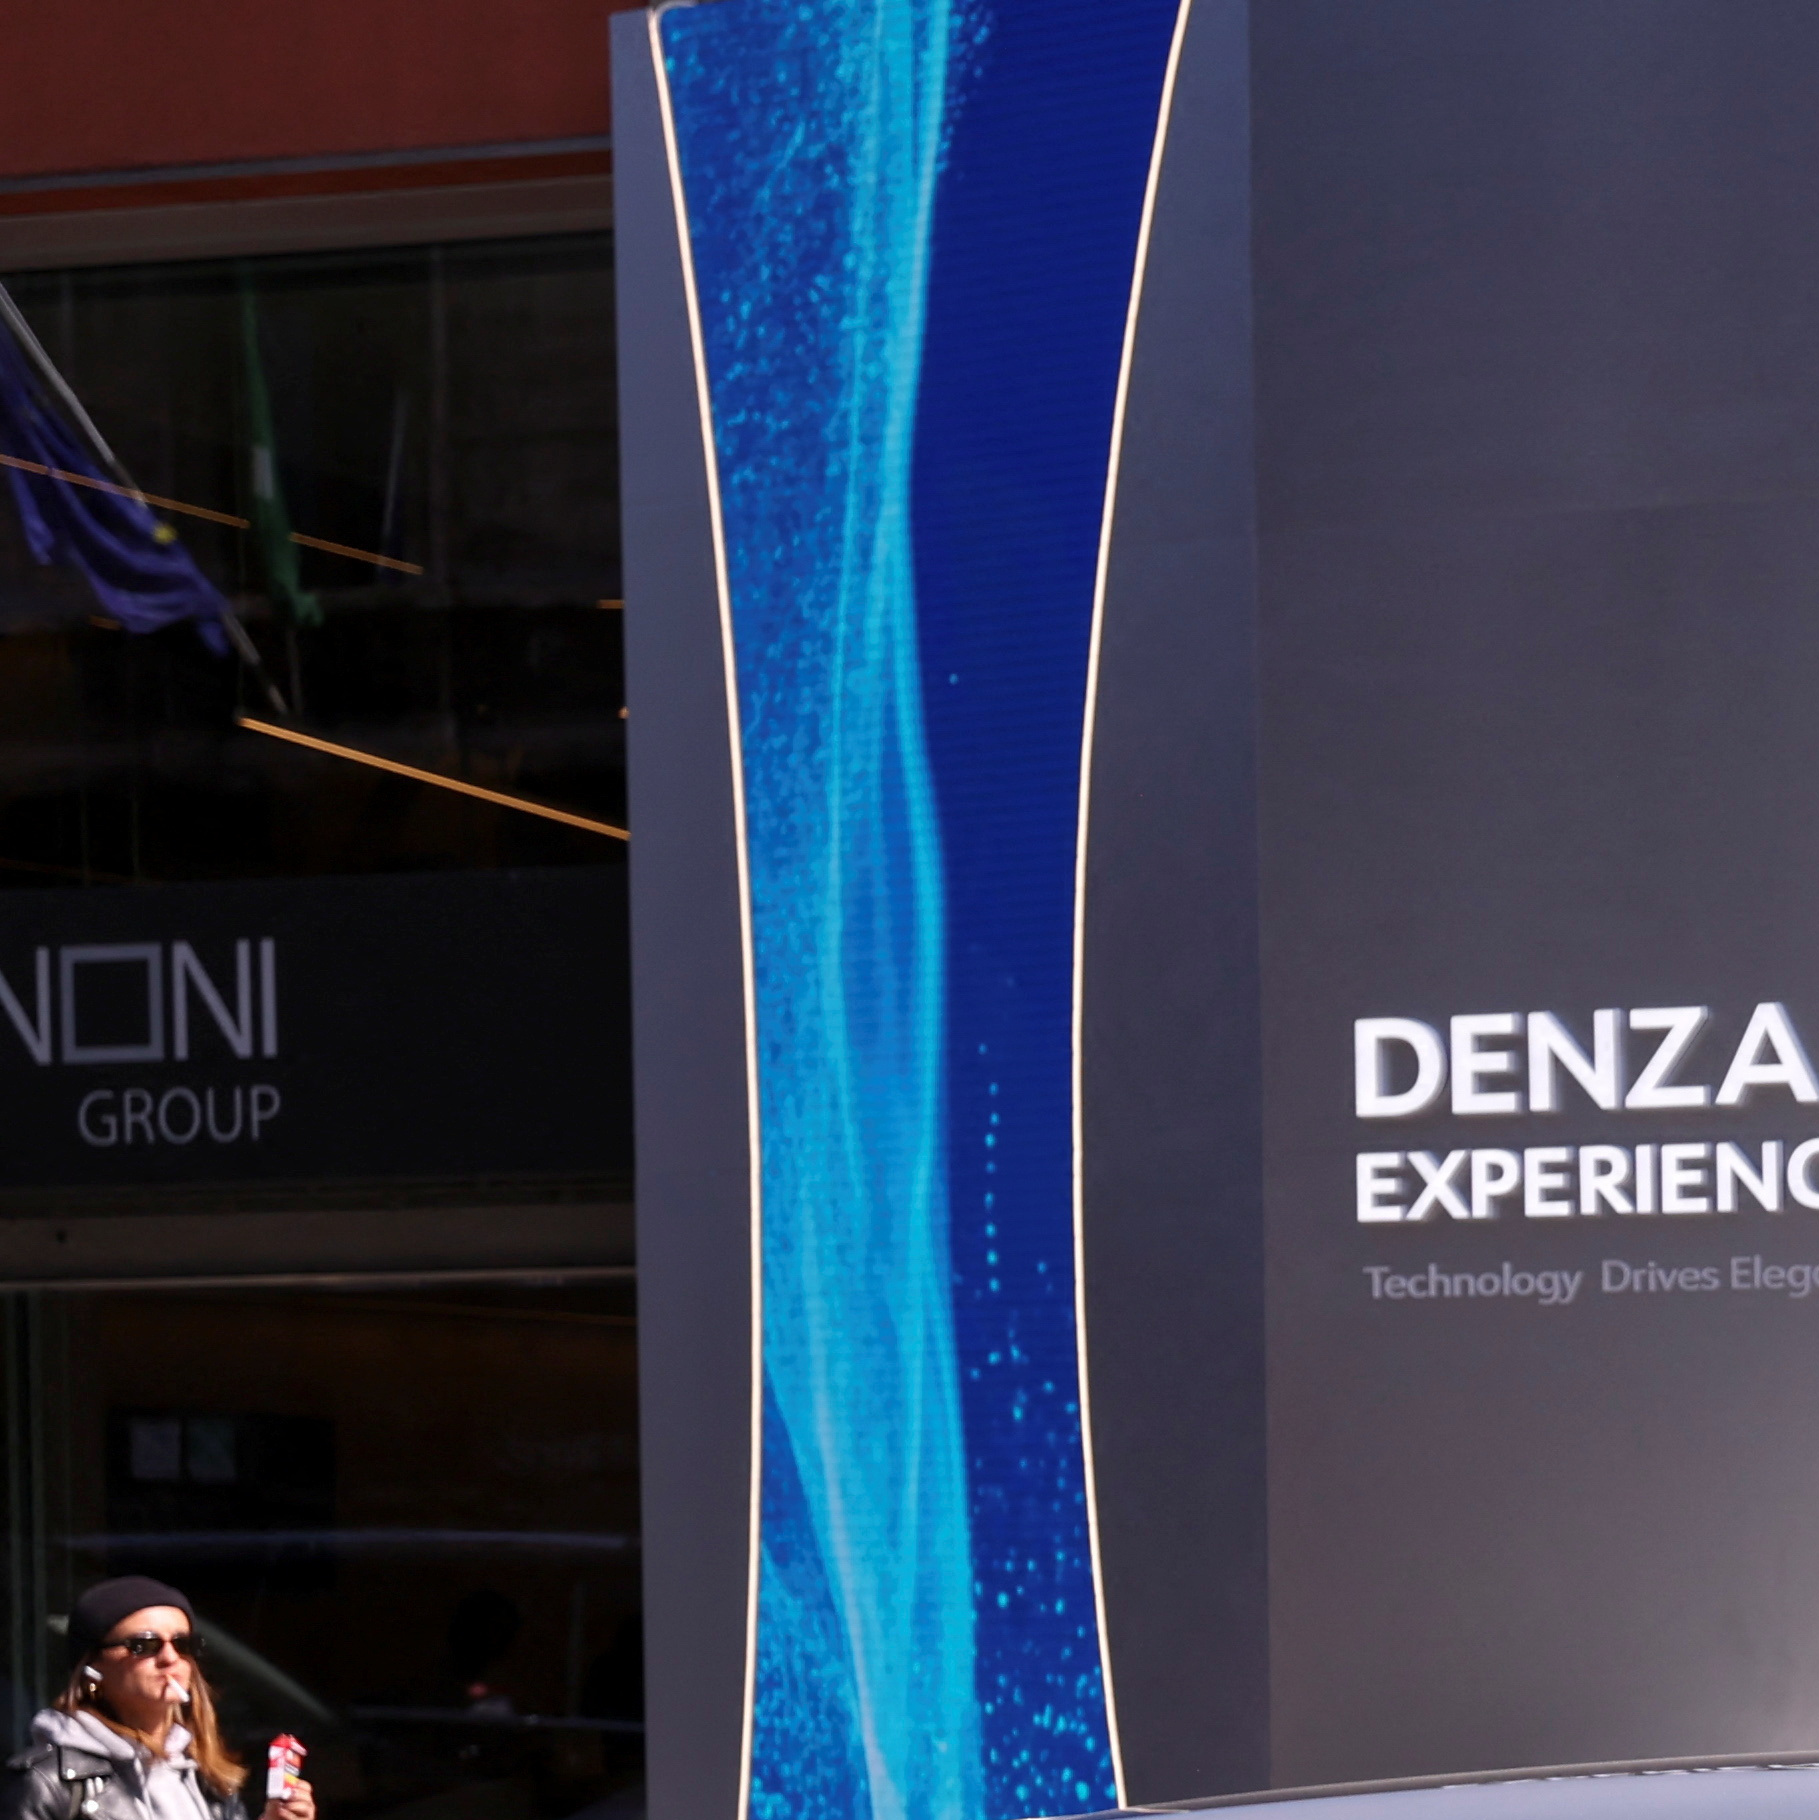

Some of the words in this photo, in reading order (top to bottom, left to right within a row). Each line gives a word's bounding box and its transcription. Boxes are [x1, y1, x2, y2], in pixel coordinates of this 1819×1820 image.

[77, 1084, 281, 1146] GROUP
[1363, 1261, 1583, 1305] Technology
[1601, 1258, 1721, 1293] Drives
